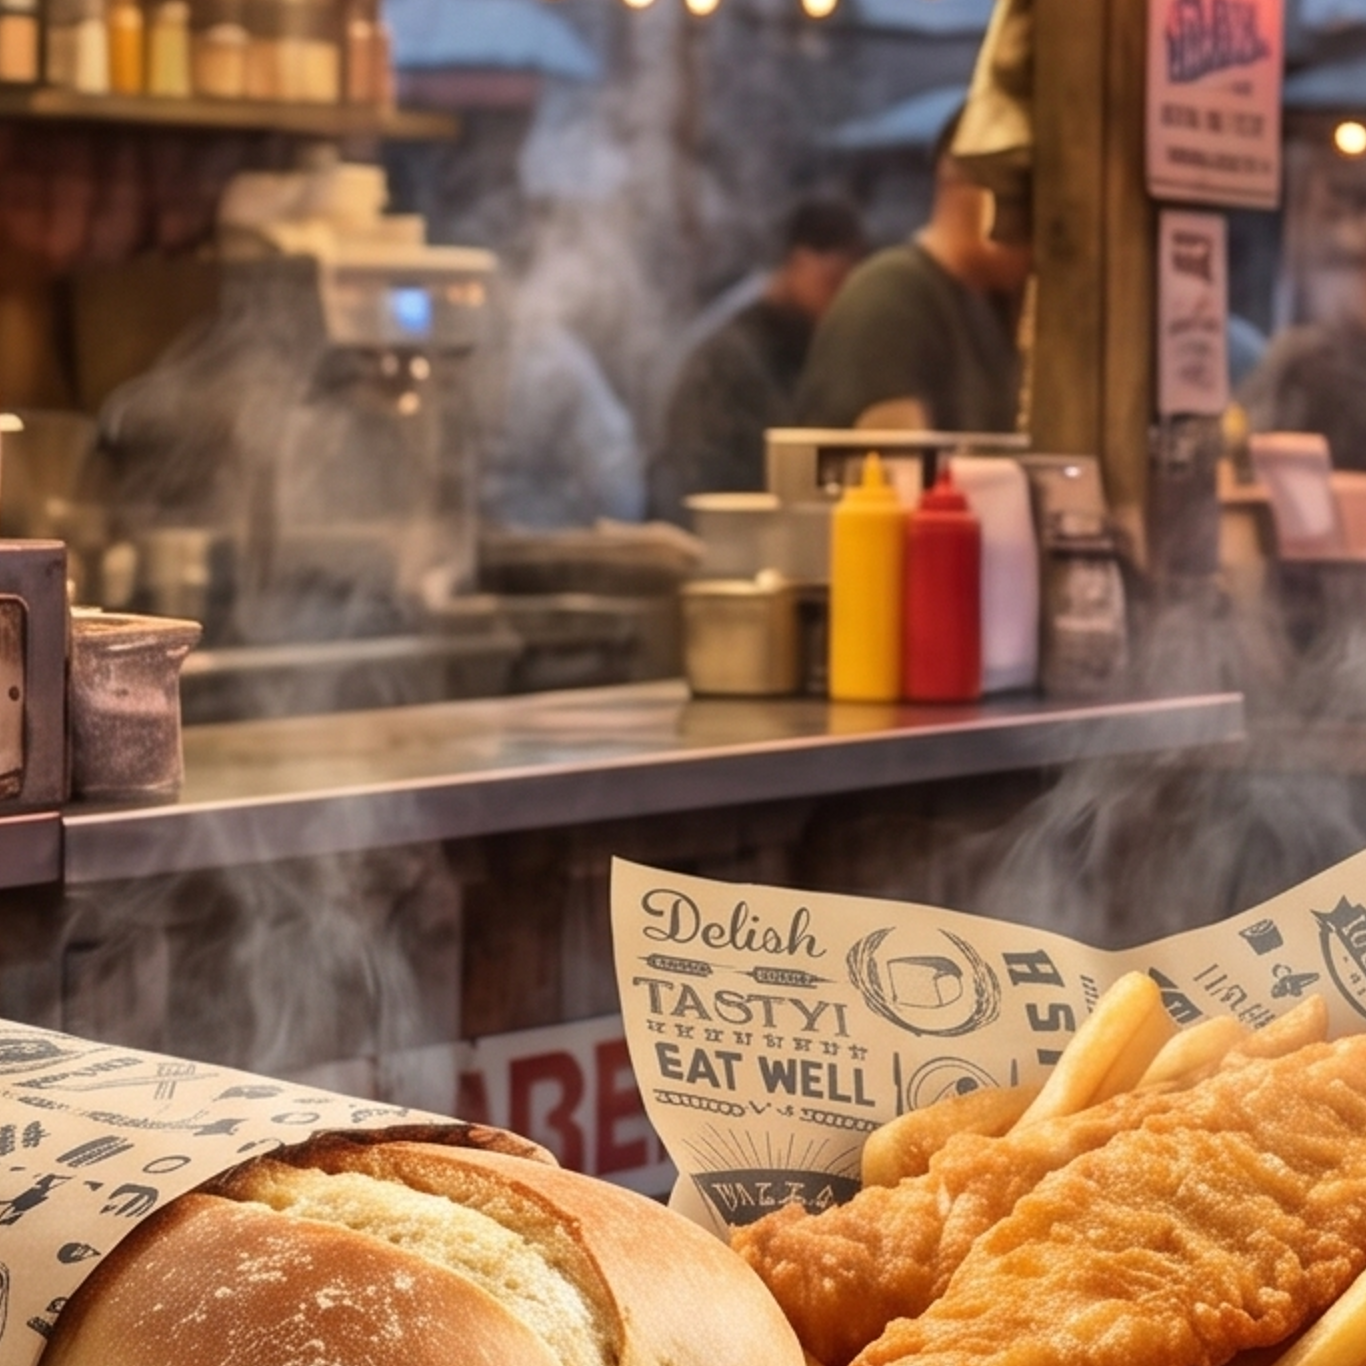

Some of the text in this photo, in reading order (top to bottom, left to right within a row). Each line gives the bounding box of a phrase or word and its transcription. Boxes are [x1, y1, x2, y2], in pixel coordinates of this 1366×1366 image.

[639, 887, 829, 960] Delish
[654, 1041, 877, 1108] EAT WELL
